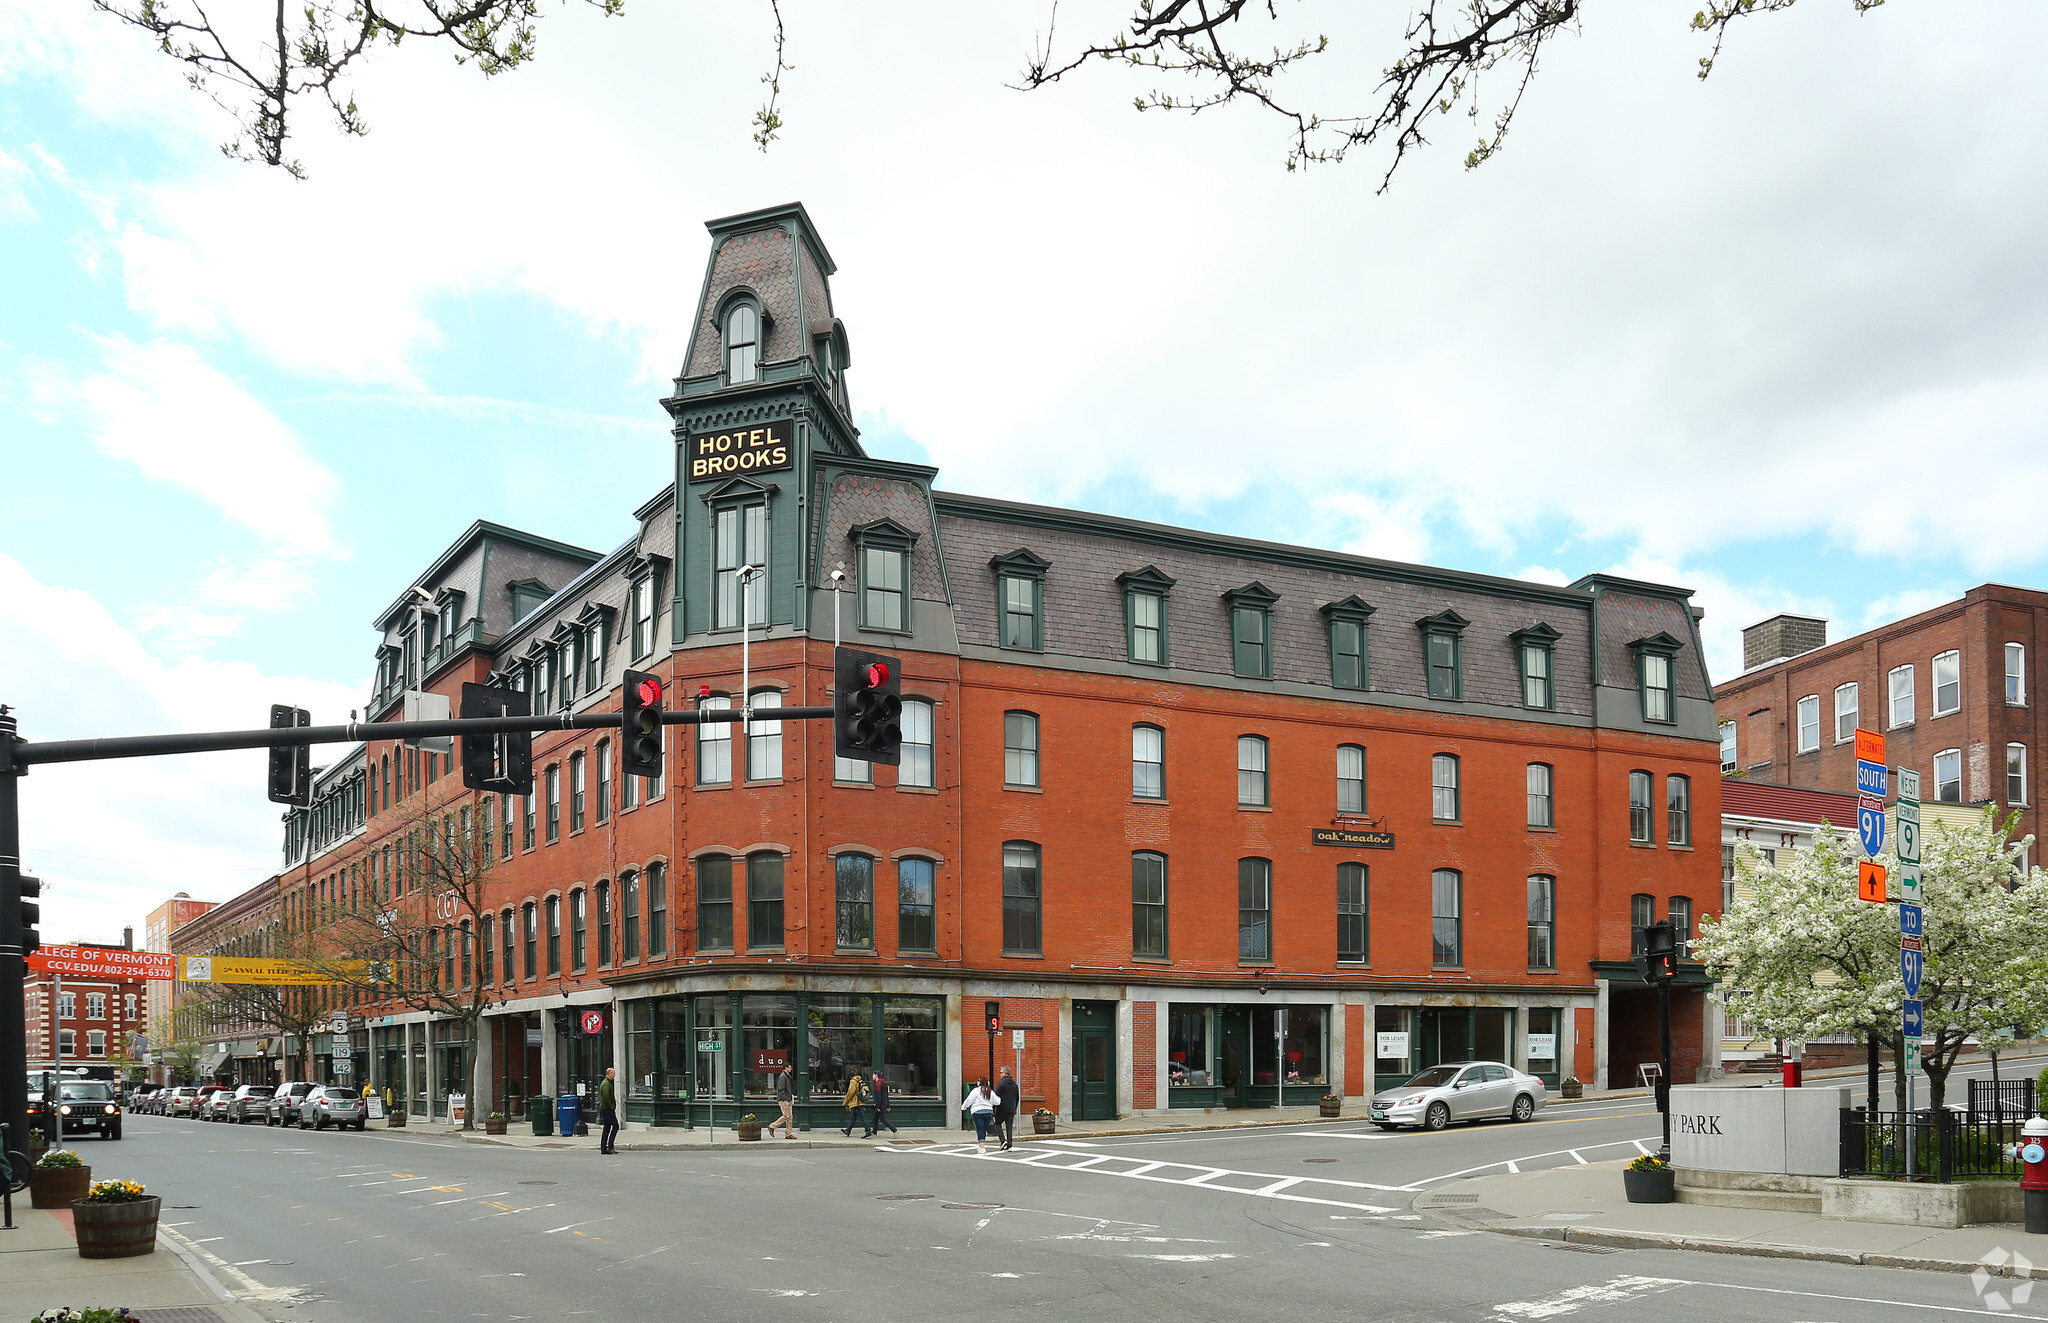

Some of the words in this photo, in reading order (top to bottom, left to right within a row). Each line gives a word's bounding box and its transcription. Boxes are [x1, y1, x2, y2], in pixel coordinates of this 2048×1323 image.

[700, 428, 780, 455] HOTEL
[693, 447, 787, 476] BROOKS
[1859, 739, 1883, 756] ALTERNATE
[1859, 767, 1886, 790] SOUTH
[1900, 773, 1916, 795] WEST
[1898, 805, 1918, 821] VERMONT
[1317, 832, 1339, 841] oak
[1862, 812, 1880, 847] 91
[1904, 825, 1913, 856] 9
[437, 889, 460, 920] CCV
[1905, 911, 1917, 929] TO
[82, 950, 100, 961] OF
[105, 952, 171, 966] VERMONT
[47, 960, 171, 978] CCV.EDU/802-254-6370
[1904, 951, 1917, 985] 91
[337, 1022, 343, 1031] 5
[992, 1018, 998, 1030] 9
[335, 1048, 348, 1057] 119
[699, 1042, 714, 1050] HIGH
[758, 1054, 783, 1065] duo
[335, 1064, 350, 1073] 142
[1681, 1114, 1724, 1135] PARK
[2031, 1136, 2041, 1145] 325
